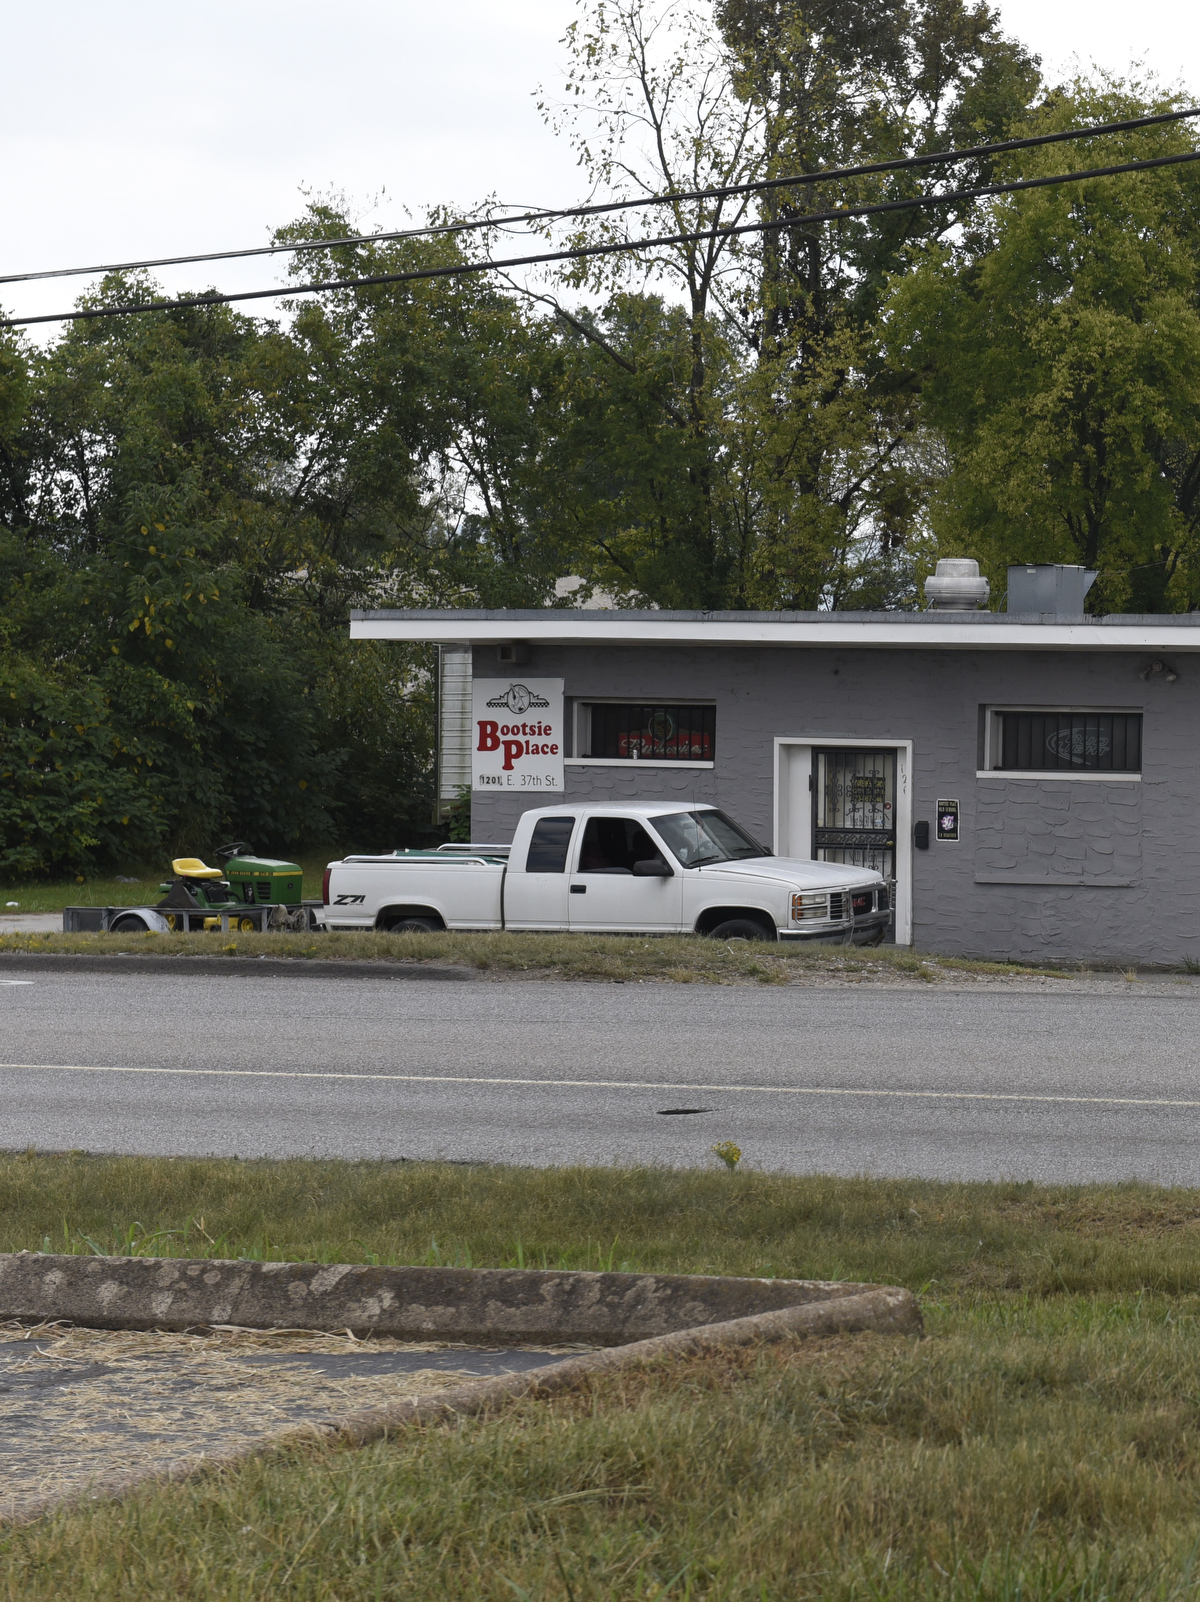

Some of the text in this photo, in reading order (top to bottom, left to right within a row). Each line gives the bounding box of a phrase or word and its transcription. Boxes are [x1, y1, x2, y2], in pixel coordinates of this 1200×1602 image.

[476, 720, 552, 751] Bootsie
[501, 739, 559, 771] Place
[520, 775, 542, 786] 37th
[545, 775, 558, 787] St.
[333, 894, 366, 905] Z71
[851, 897, 867, 908] MC
